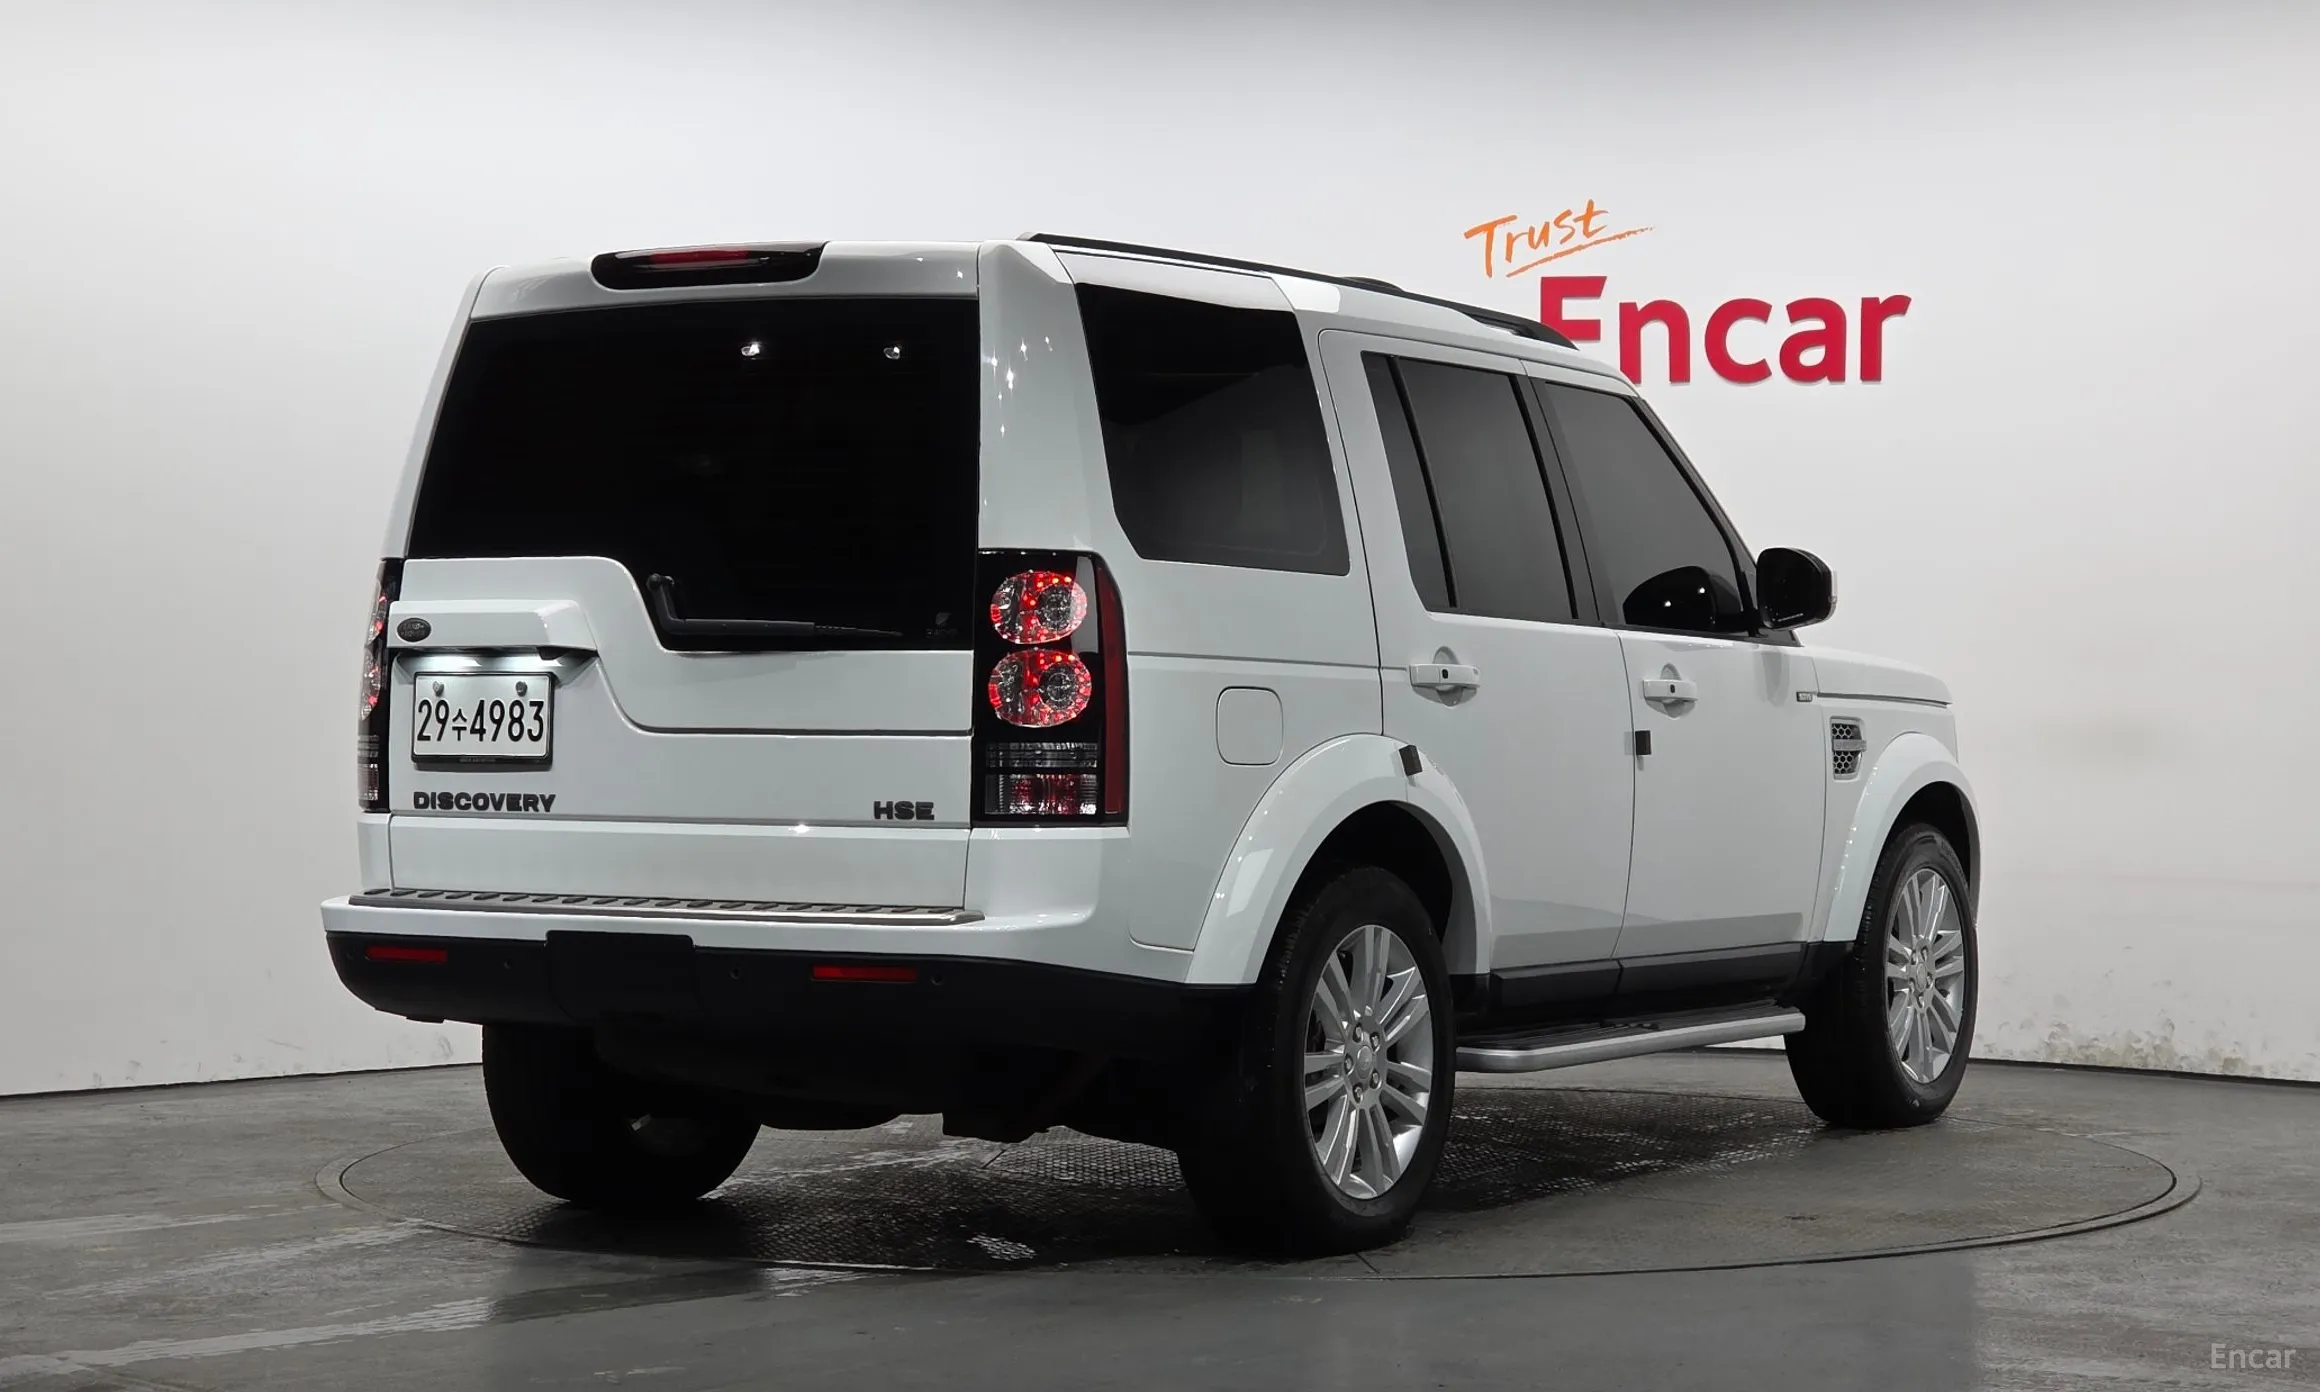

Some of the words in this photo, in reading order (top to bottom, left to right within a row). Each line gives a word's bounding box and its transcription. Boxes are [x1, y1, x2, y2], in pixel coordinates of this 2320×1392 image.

[1464, 199, 1609, 278] Trust
[416, 699, 545, 743] 29수4983
[413, 791, 556, 813] DISCOVERY
[873, 800, 935, 821] HSE
